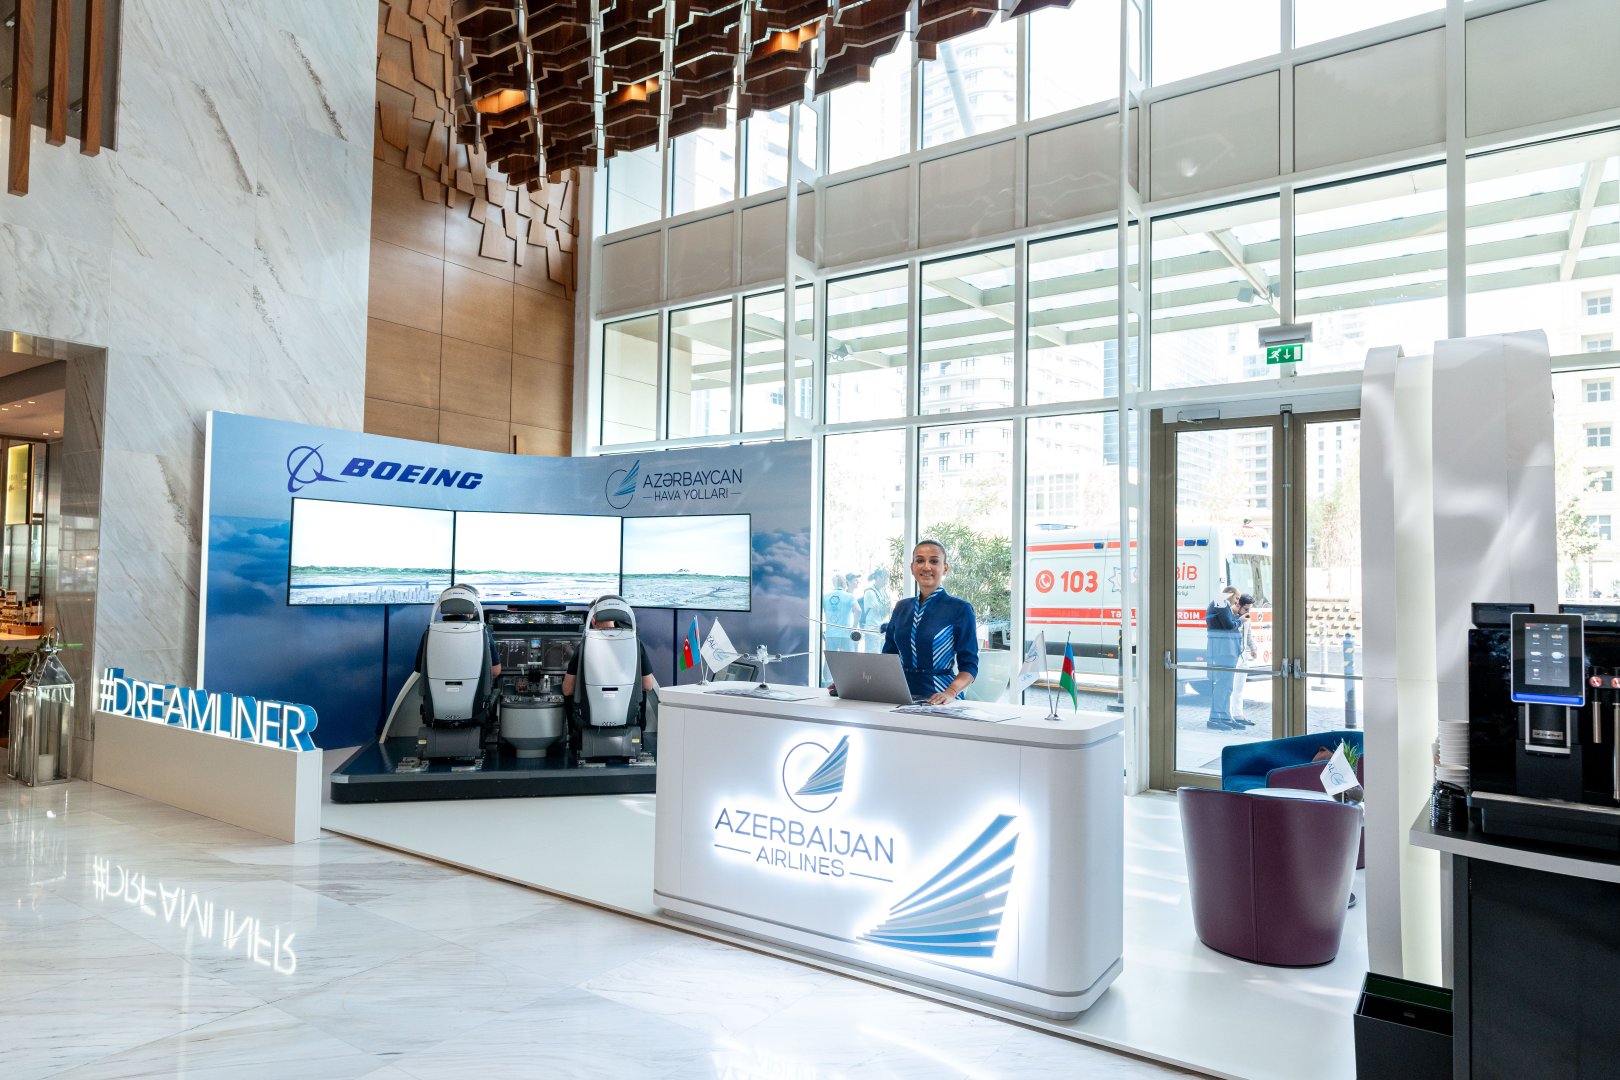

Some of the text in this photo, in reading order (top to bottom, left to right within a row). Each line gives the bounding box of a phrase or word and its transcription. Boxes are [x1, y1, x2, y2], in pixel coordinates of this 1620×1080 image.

[340, 457, 484, 490] BOEING
[642, 468, 743, 489] AZƏRBAYCAN
[654, 487, 729, 502] HAVA YOLLARI
[1061, 570, 1098, 593] 103
[862, 670, 872, 684] hp
[100, 667, 318, 753] #DREAMLINER
[714, 807, 894, 865] AZERBAIJAN
[756, 846, 845, 878] AIRLINES
